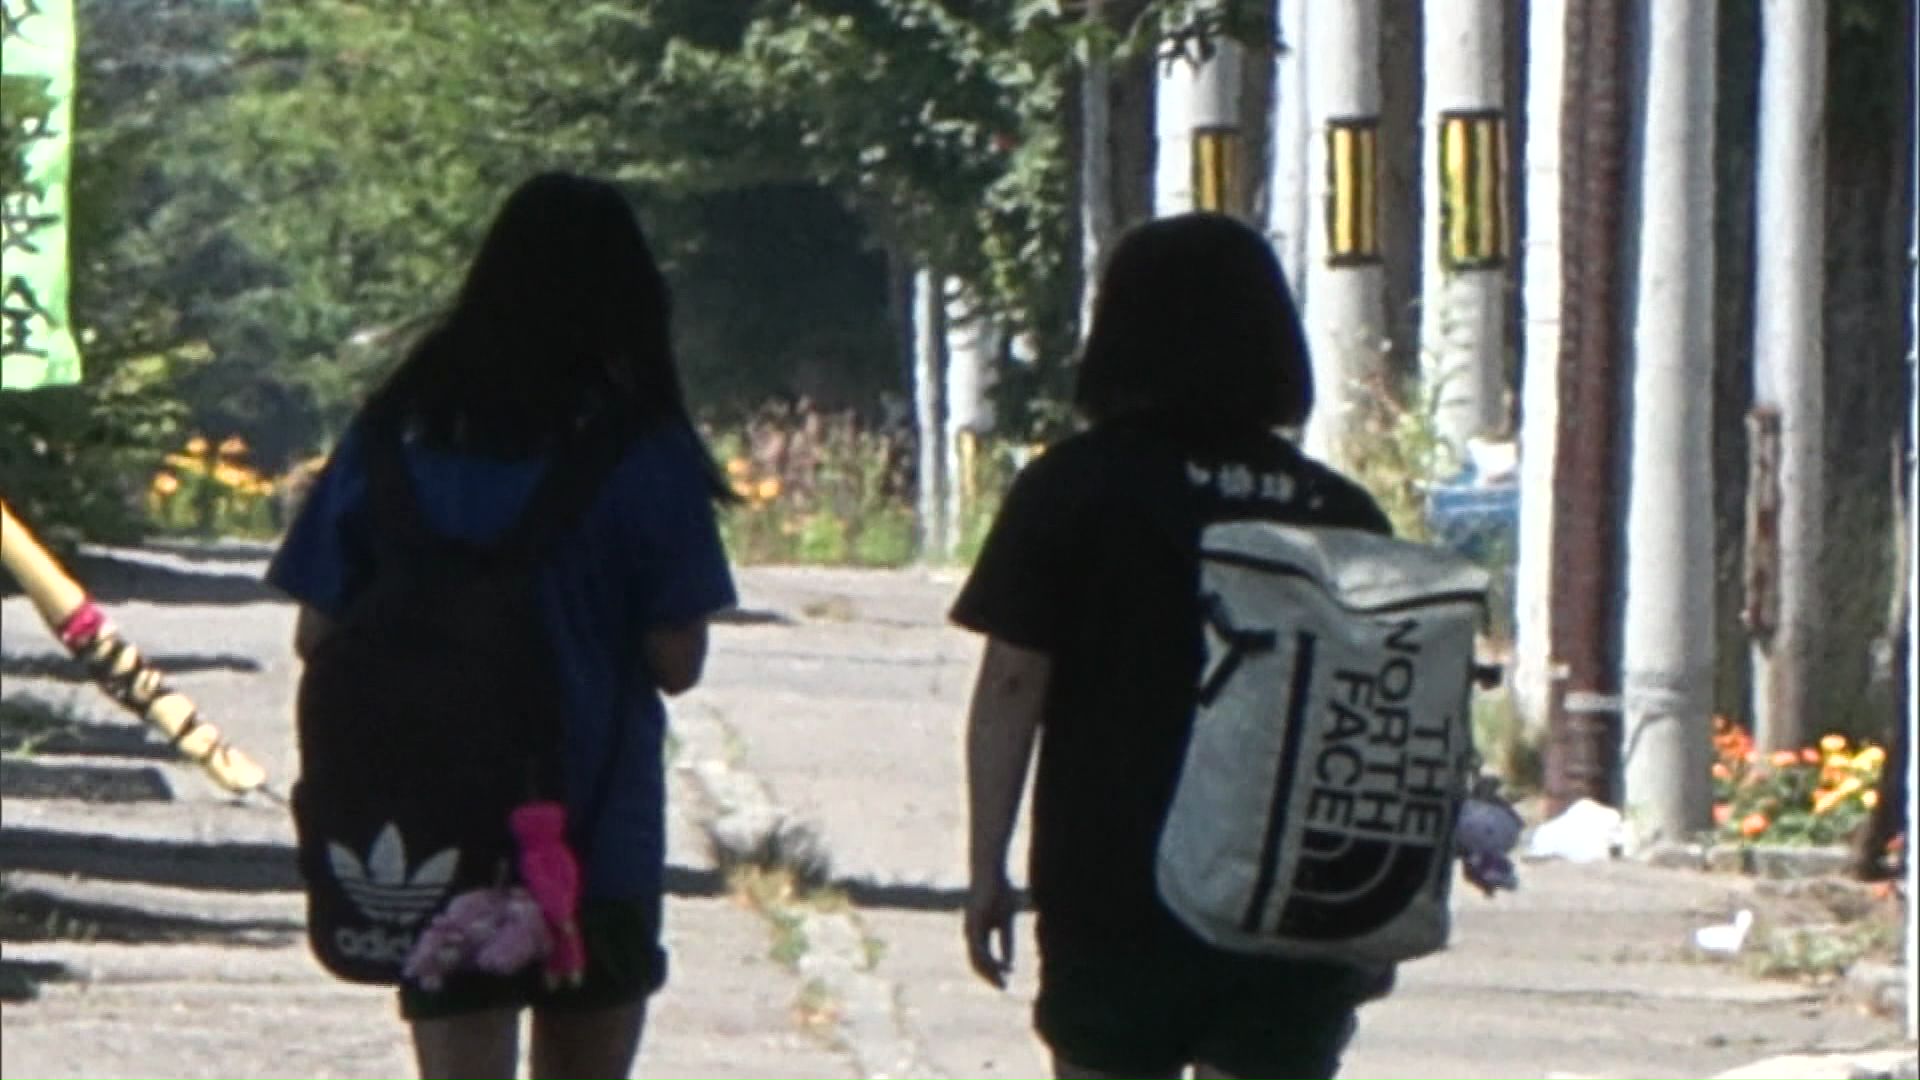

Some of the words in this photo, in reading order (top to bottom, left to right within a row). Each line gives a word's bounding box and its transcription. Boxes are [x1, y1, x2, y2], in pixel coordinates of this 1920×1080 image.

[1304, 665, 1375, 829] FACE
[1355, 619, 1421, 834] NORTH
[1400, 716, 1453, 846] THE
